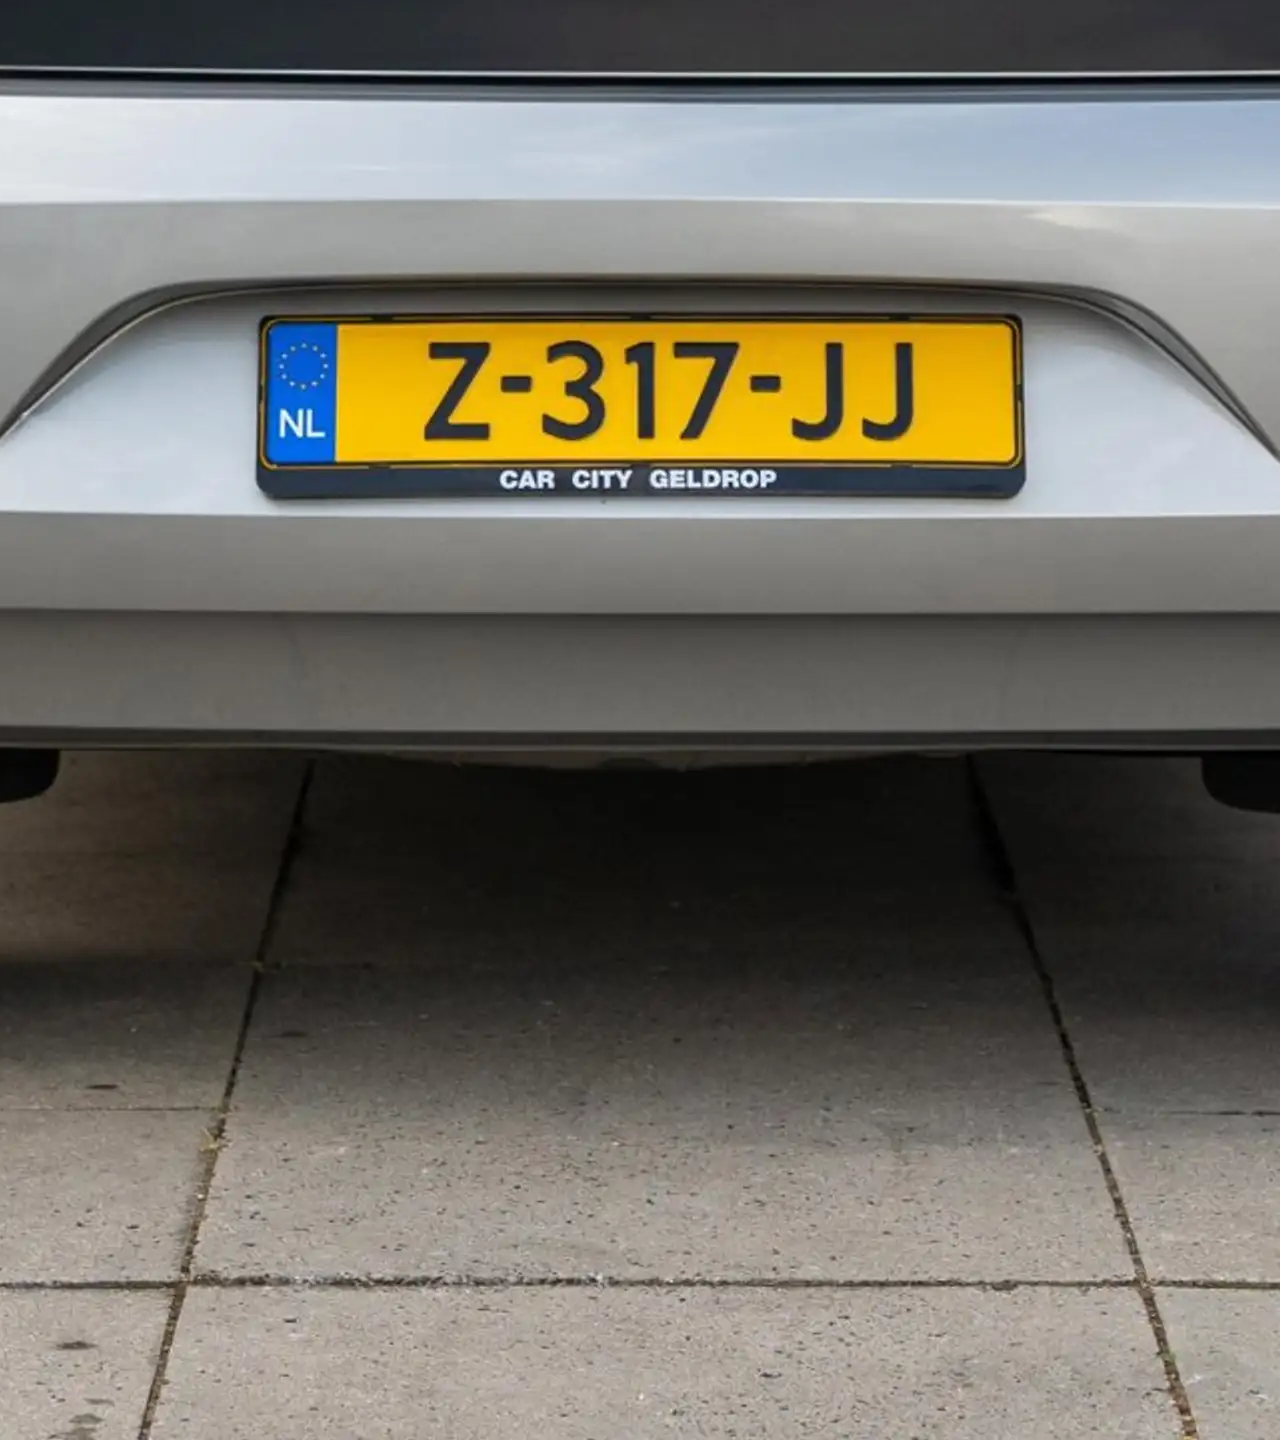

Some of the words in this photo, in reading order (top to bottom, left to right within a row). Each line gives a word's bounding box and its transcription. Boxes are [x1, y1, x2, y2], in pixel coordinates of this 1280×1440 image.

[423, 341, 914, 442] Z-317-JJ
[279, 409, 325, 439] NL
[499, 469, 556, 491] CAR
[572, 470, 634, 491] CITY
[649, 469, 778, 490] GELDROP
